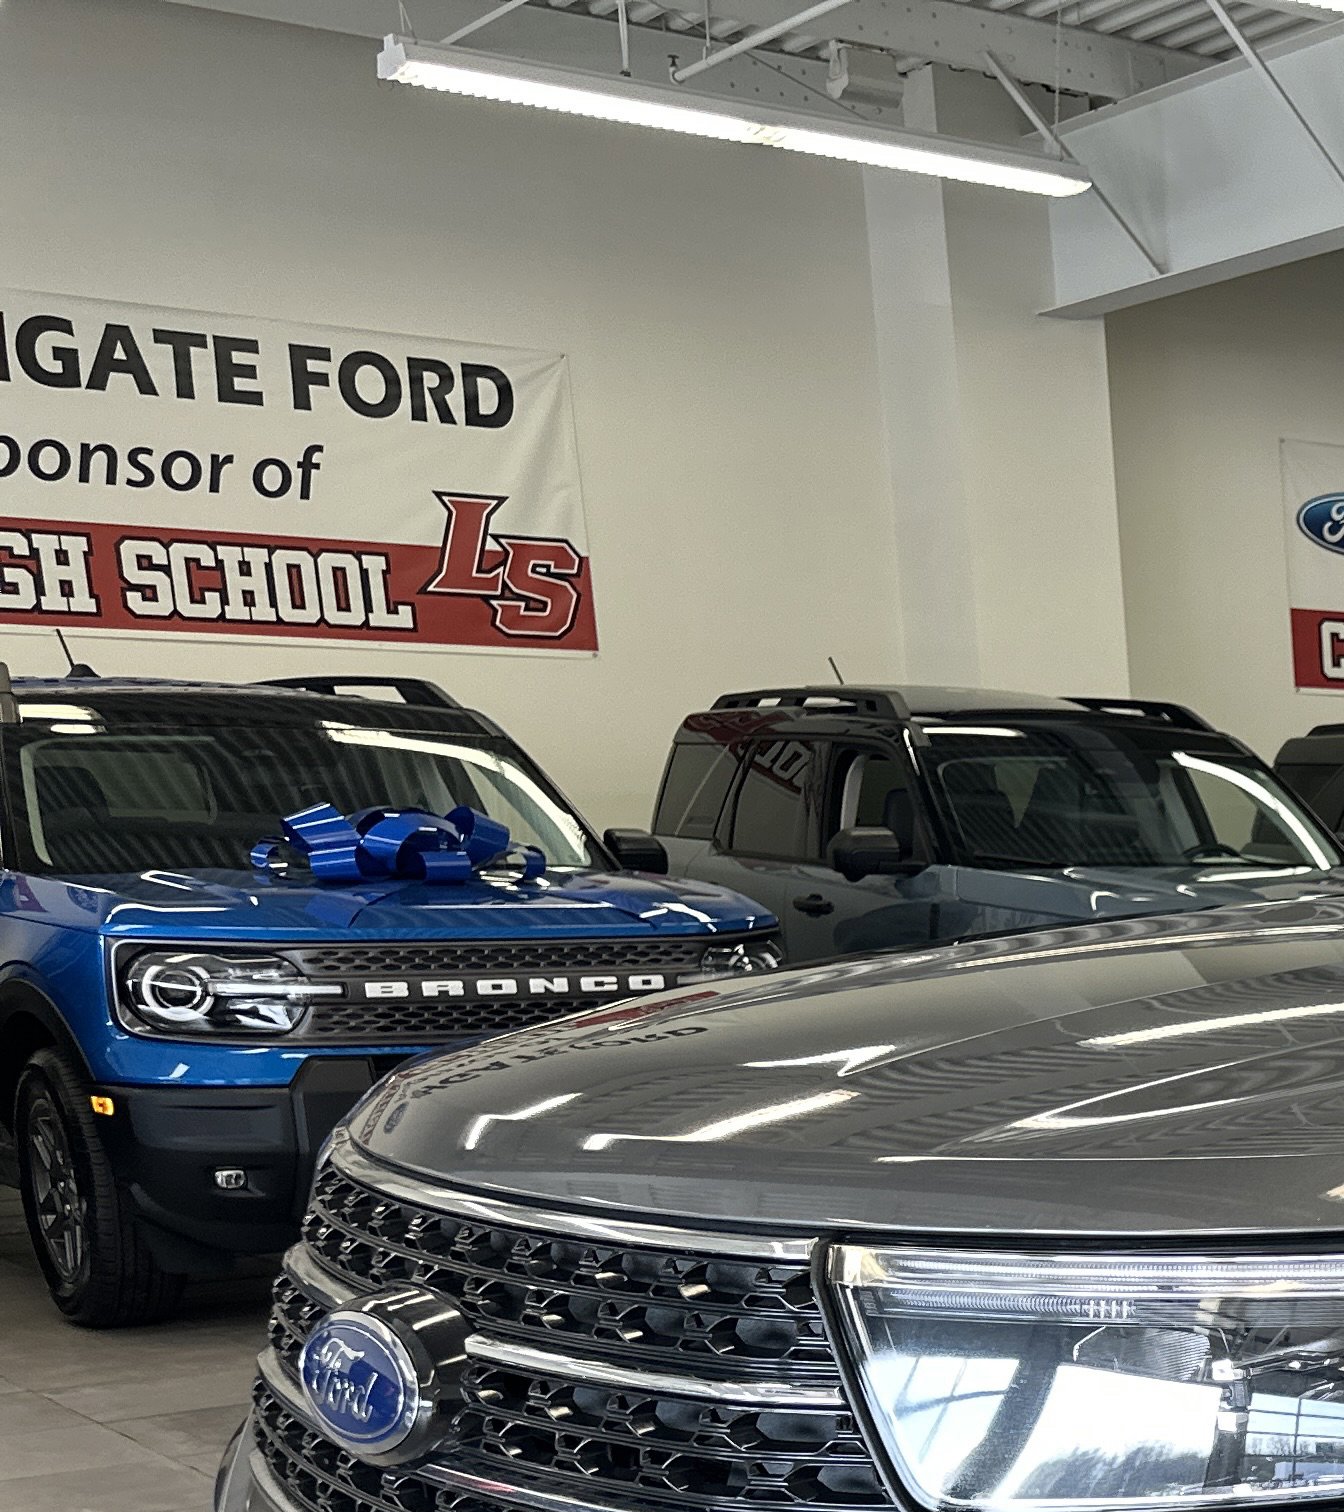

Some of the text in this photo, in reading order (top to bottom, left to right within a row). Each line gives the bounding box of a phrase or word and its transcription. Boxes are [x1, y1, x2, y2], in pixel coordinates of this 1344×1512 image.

[0, 311, 515, 428] GATE FORD
[252, 444, 324, 500] of
[117, 538, 417, 632] SCHOOL
[364, 974, 665, 998] BRONCO
